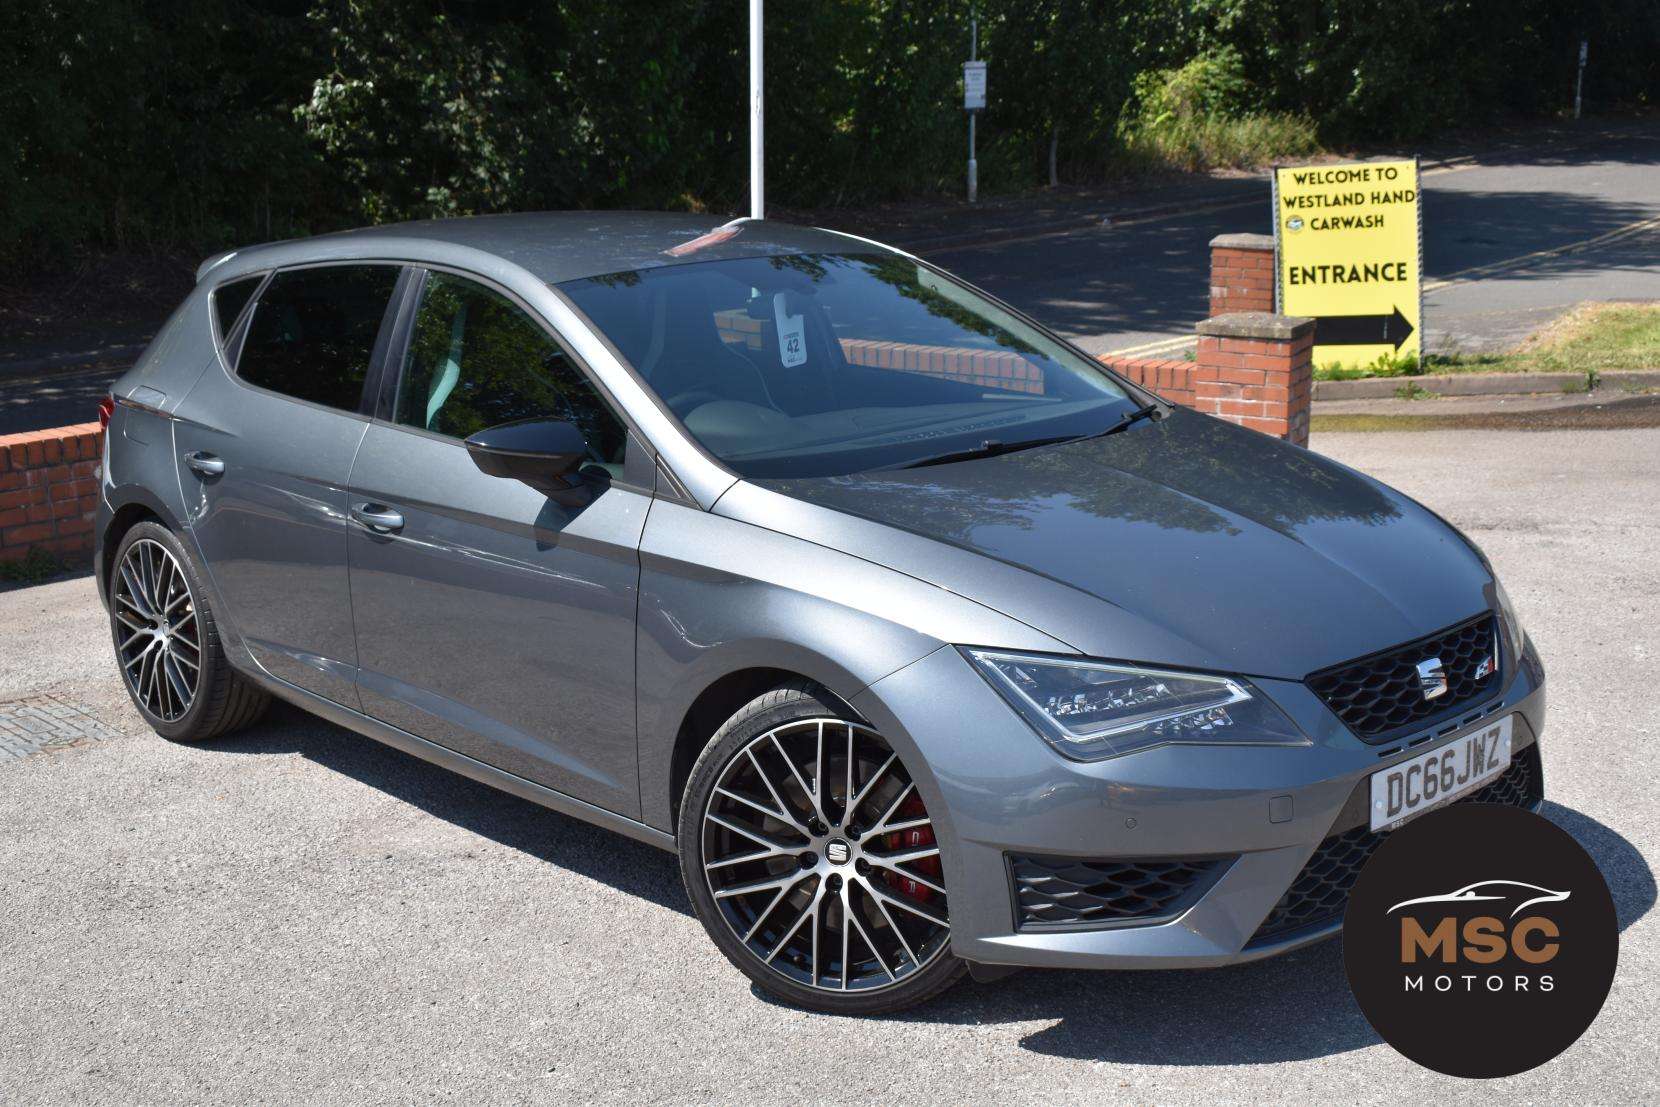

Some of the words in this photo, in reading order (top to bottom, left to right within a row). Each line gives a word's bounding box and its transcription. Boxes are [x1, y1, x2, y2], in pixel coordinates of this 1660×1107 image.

[1293, 168, 1370, 185] WELCOME
[1375, 167, 1398, 181] TO
[1283, 192, 1365, 208] WESTLAND
[1371, 190, 1415, 205] HAND
[1310, 215, 1384, 231] CARWASH
[1289, 262, 1407, 285] ENTRANCE
[787, 338, 800, 353] 42
